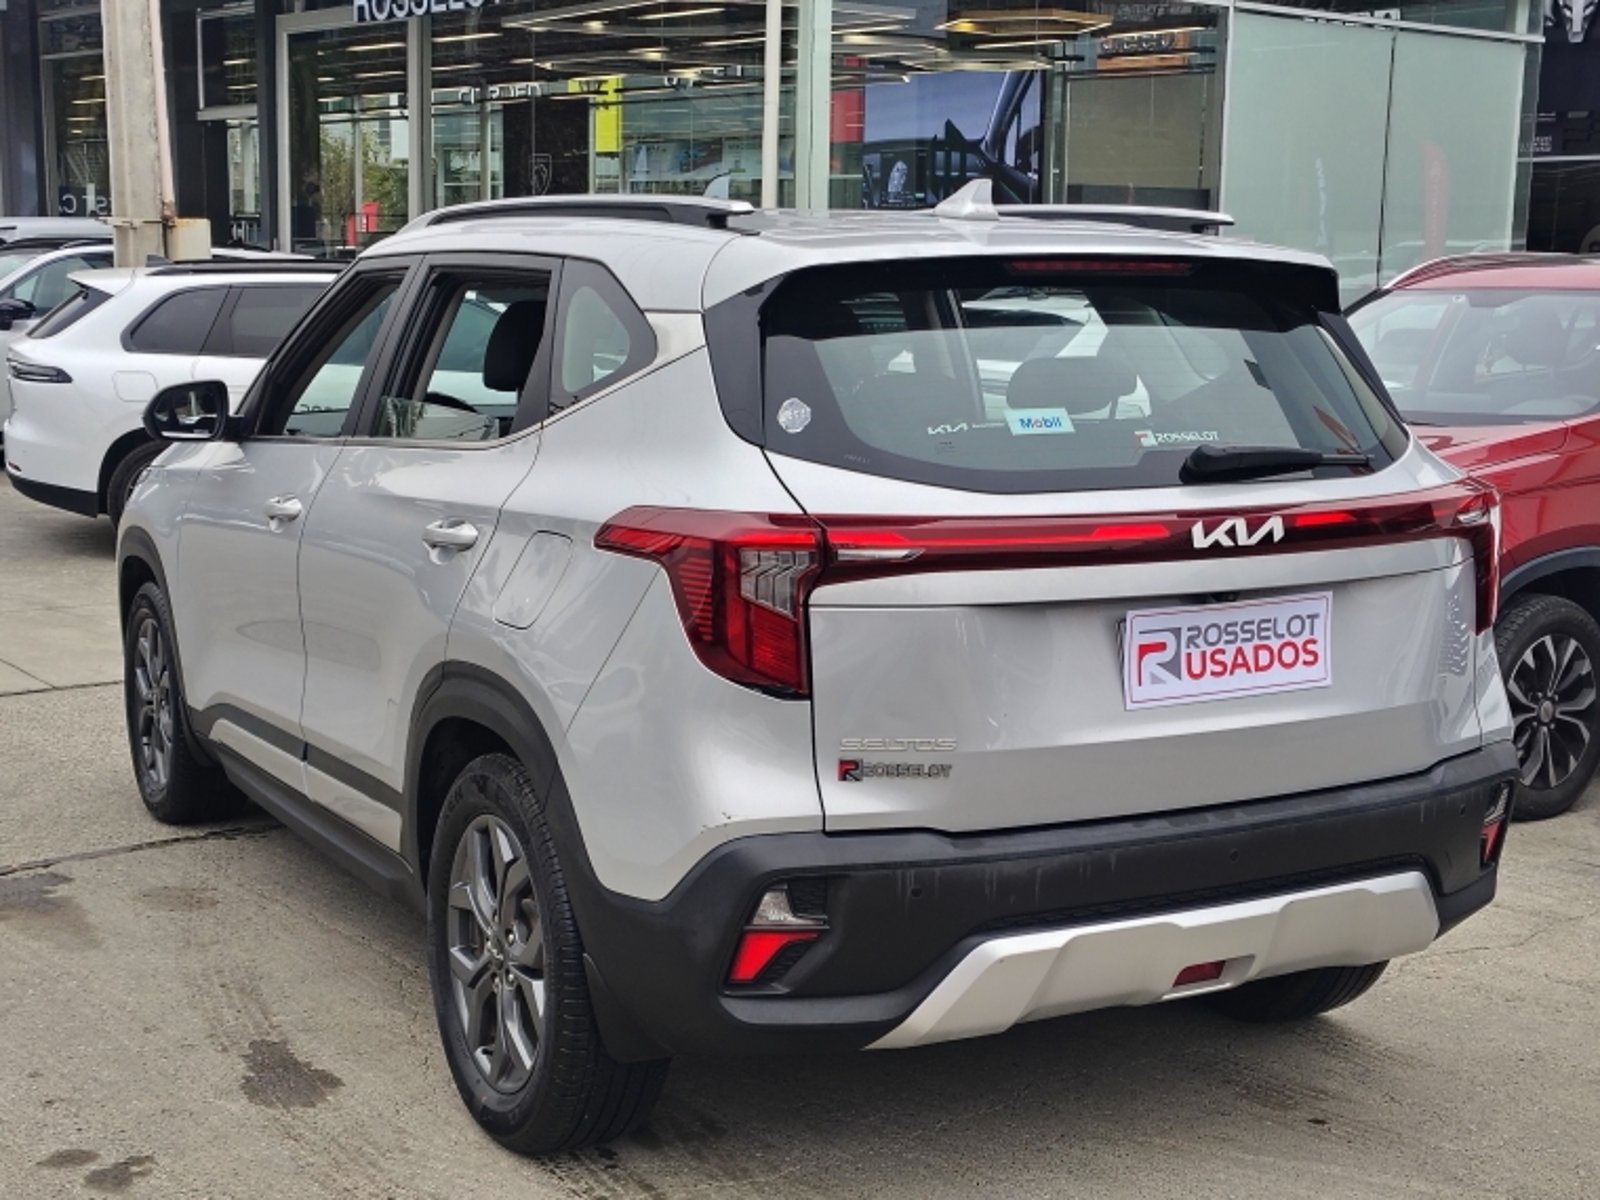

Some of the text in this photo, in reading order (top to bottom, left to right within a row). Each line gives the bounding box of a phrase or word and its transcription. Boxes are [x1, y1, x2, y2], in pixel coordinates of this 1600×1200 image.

[1191, 515, 1285, 549] KIA
[1186, 612, 1320, 649] ROSSELOT
[1186, 638, 1319, 680] USADOS
